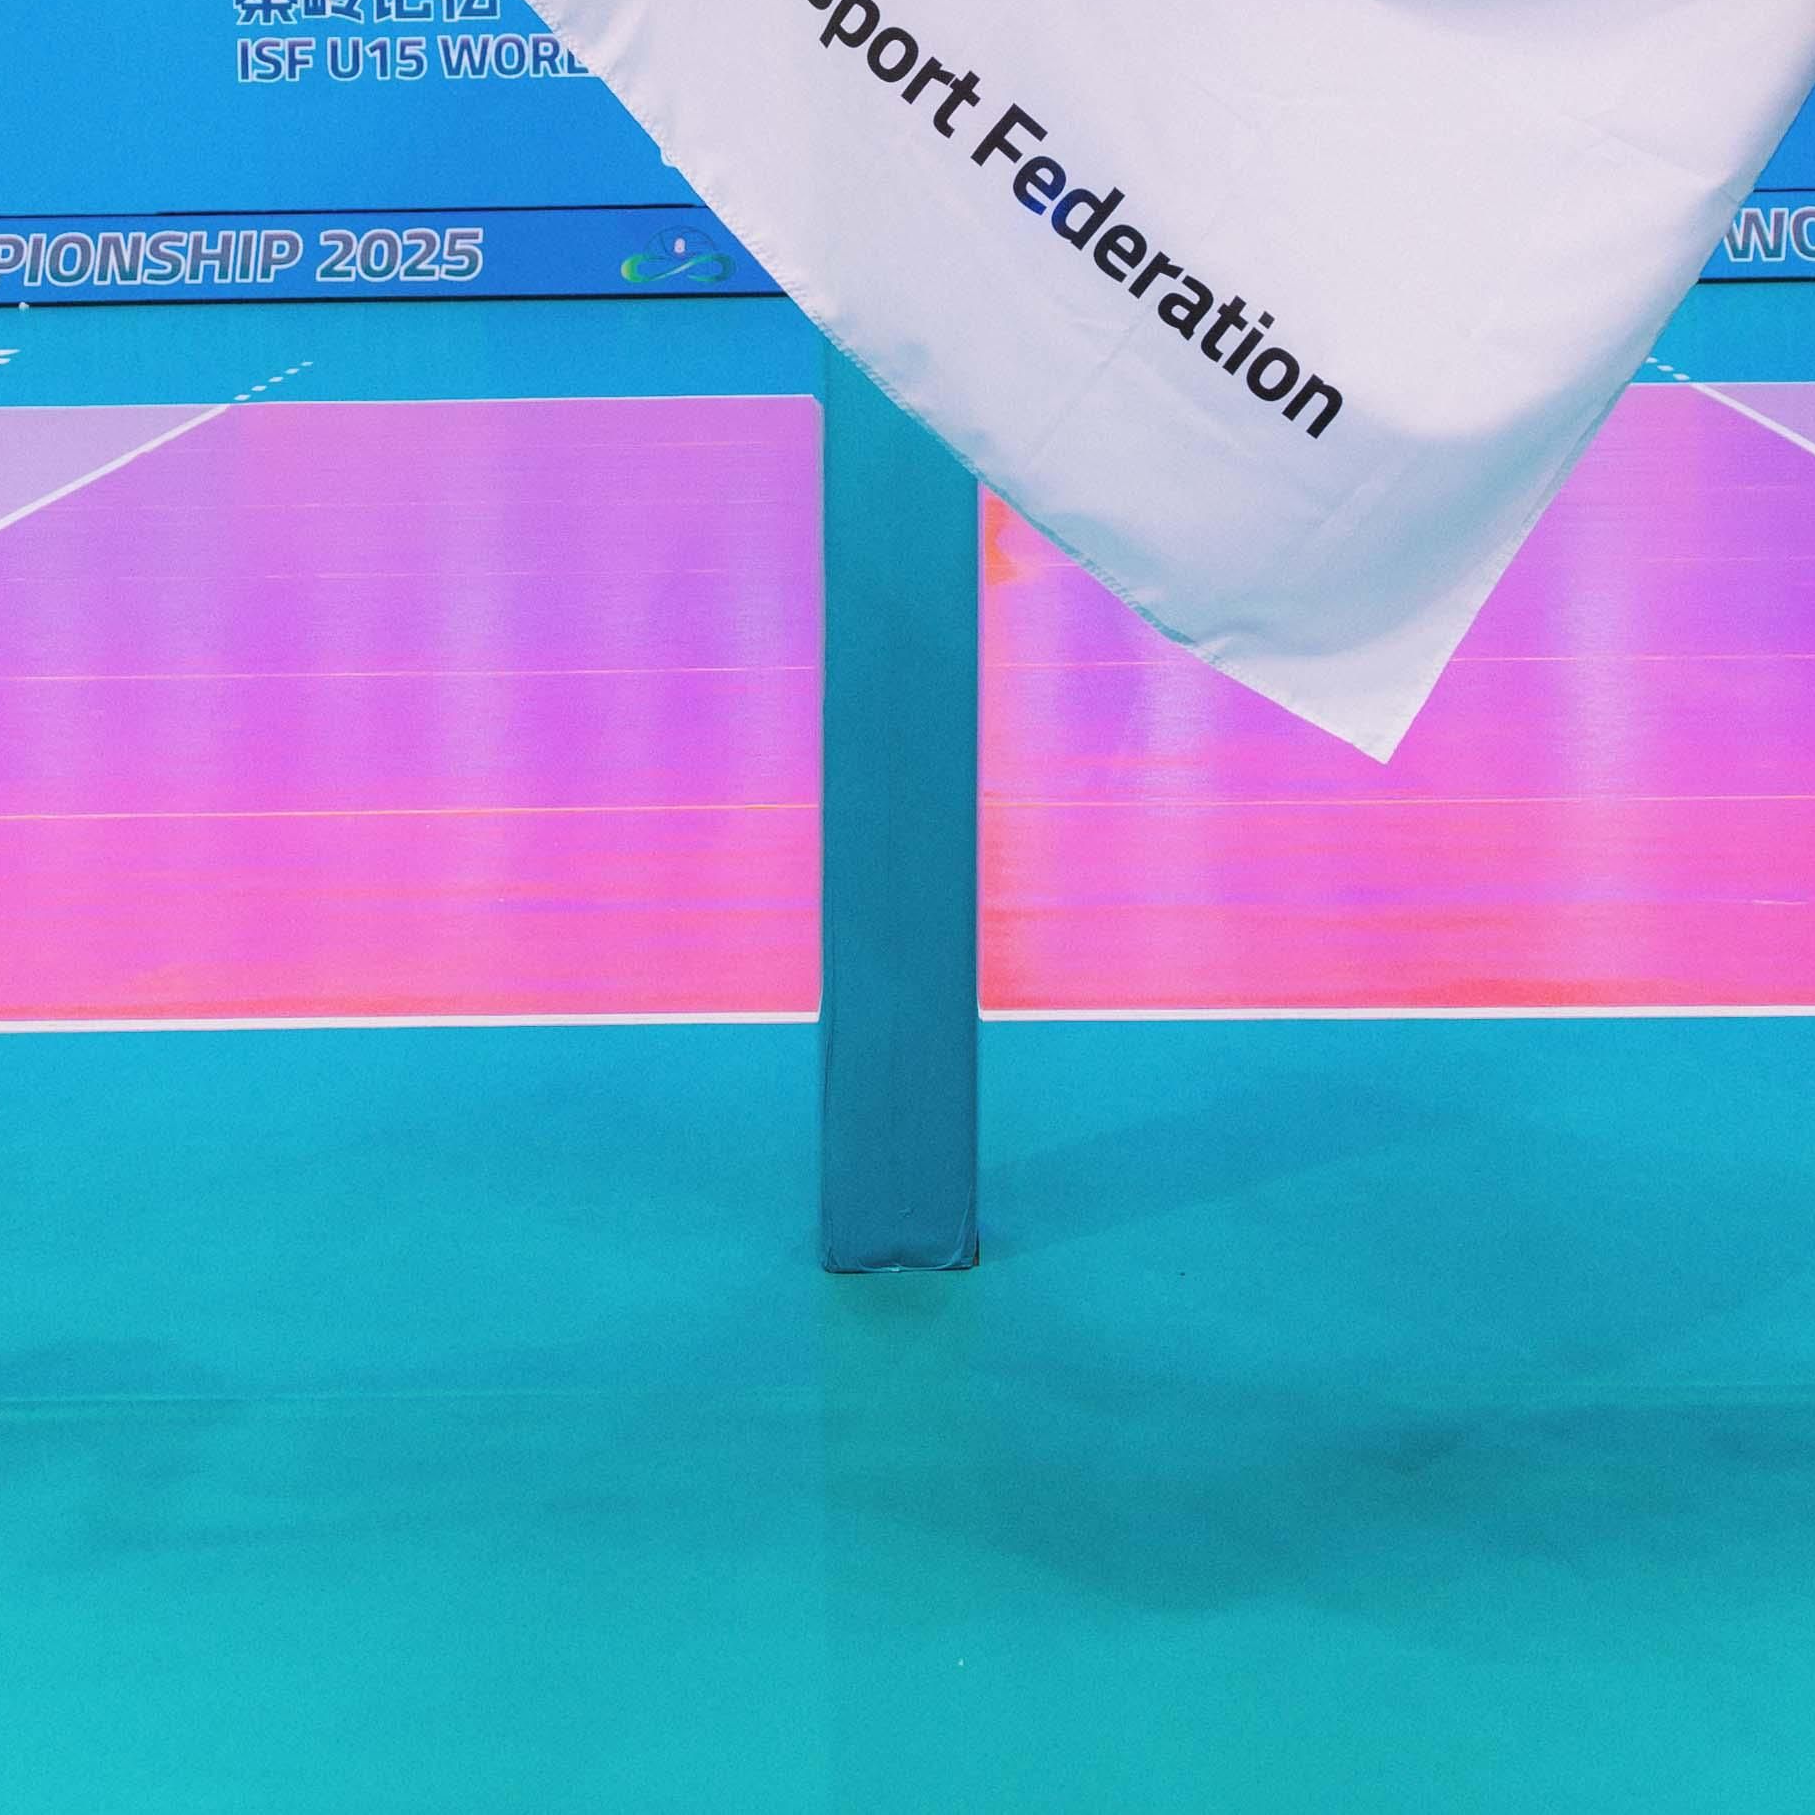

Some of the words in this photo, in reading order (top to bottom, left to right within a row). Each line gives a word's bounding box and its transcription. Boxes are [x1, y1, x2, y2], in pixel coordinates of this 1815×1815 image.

[237, 36, 317, 83] ISF
[327, 35, 428, 81] U15
[438, 33, 601, 81] WORL
[315, 227, 485, 283] 2025
[970, 102, 1344, 440] Federation
